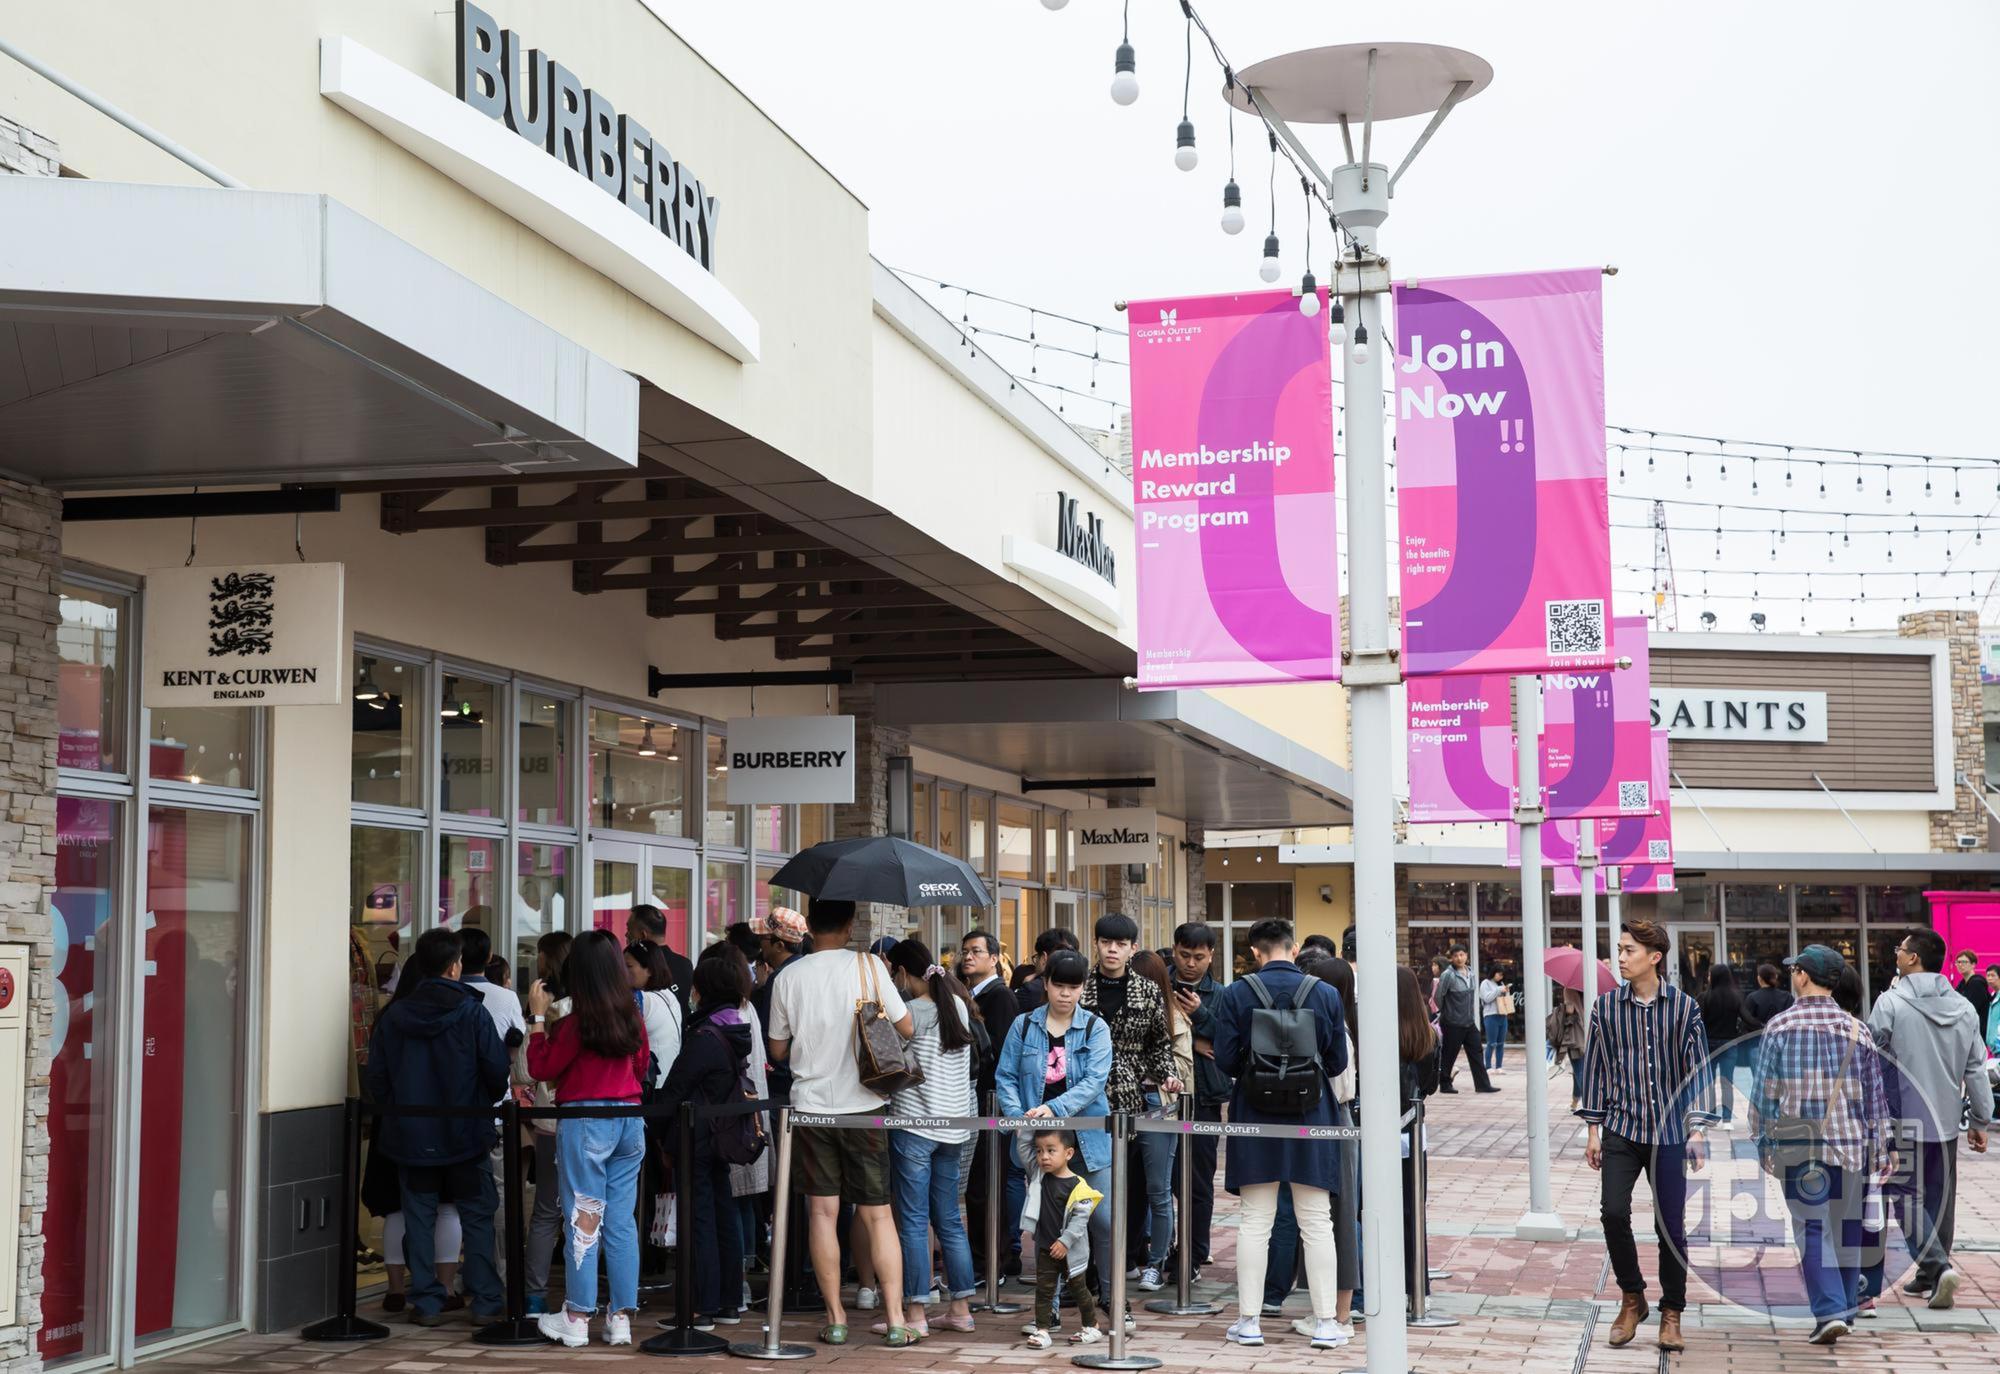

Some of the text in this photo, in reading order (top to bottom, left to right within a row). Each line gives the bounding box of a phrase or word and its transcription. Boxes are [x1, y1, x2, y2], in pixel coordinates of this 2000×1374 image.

[456, 0, 720, 276] BURBERRY
[1137, 326, 1201, 338] GLORIA OUTLETS
[1401, 329, 1504, 373] Join
[1401, 385, 1507, 420] Now
[1141, 441, 1291, 468] Membership
[1142, 474, 1236, 499] Reward
[1143, 510, 1249, 533] Program
[1406, 536, 1426, 547] Enjoy
[1406, 547, 1450, 559] the benefits
[1407, 563, 1446, 575] right away
[1146, 648, 1191, 659] Membership
[1550, 658, 1570, 667] Join
[1546, 674, 1599, 690] Now
[213, 690, 265, 699] ENGLAND
[1411, 699, 1489, 712] Membership
[1650, 699, 1806, 730] SAINTS
[1412, 715, 1461, 728] Reward
[1412, 733, 1468, 745] Program
[733, 751, 847, 769] BURBERRY
[1080, 827, 1149, 845] MaxMara
[919, 883, 961, 891] GEOX
[801, 1115, 836, 1125] OUTLETS
[884, 1118, 950, 1127] GLORIA OUTLETS
[998, 1118, 1065, 1127] GLORIA OUTLETS
[1193, 1123, 1260, 1134] GLORIA OUTLETS
[1309, 1127, 1340, 1137] GLORIA
